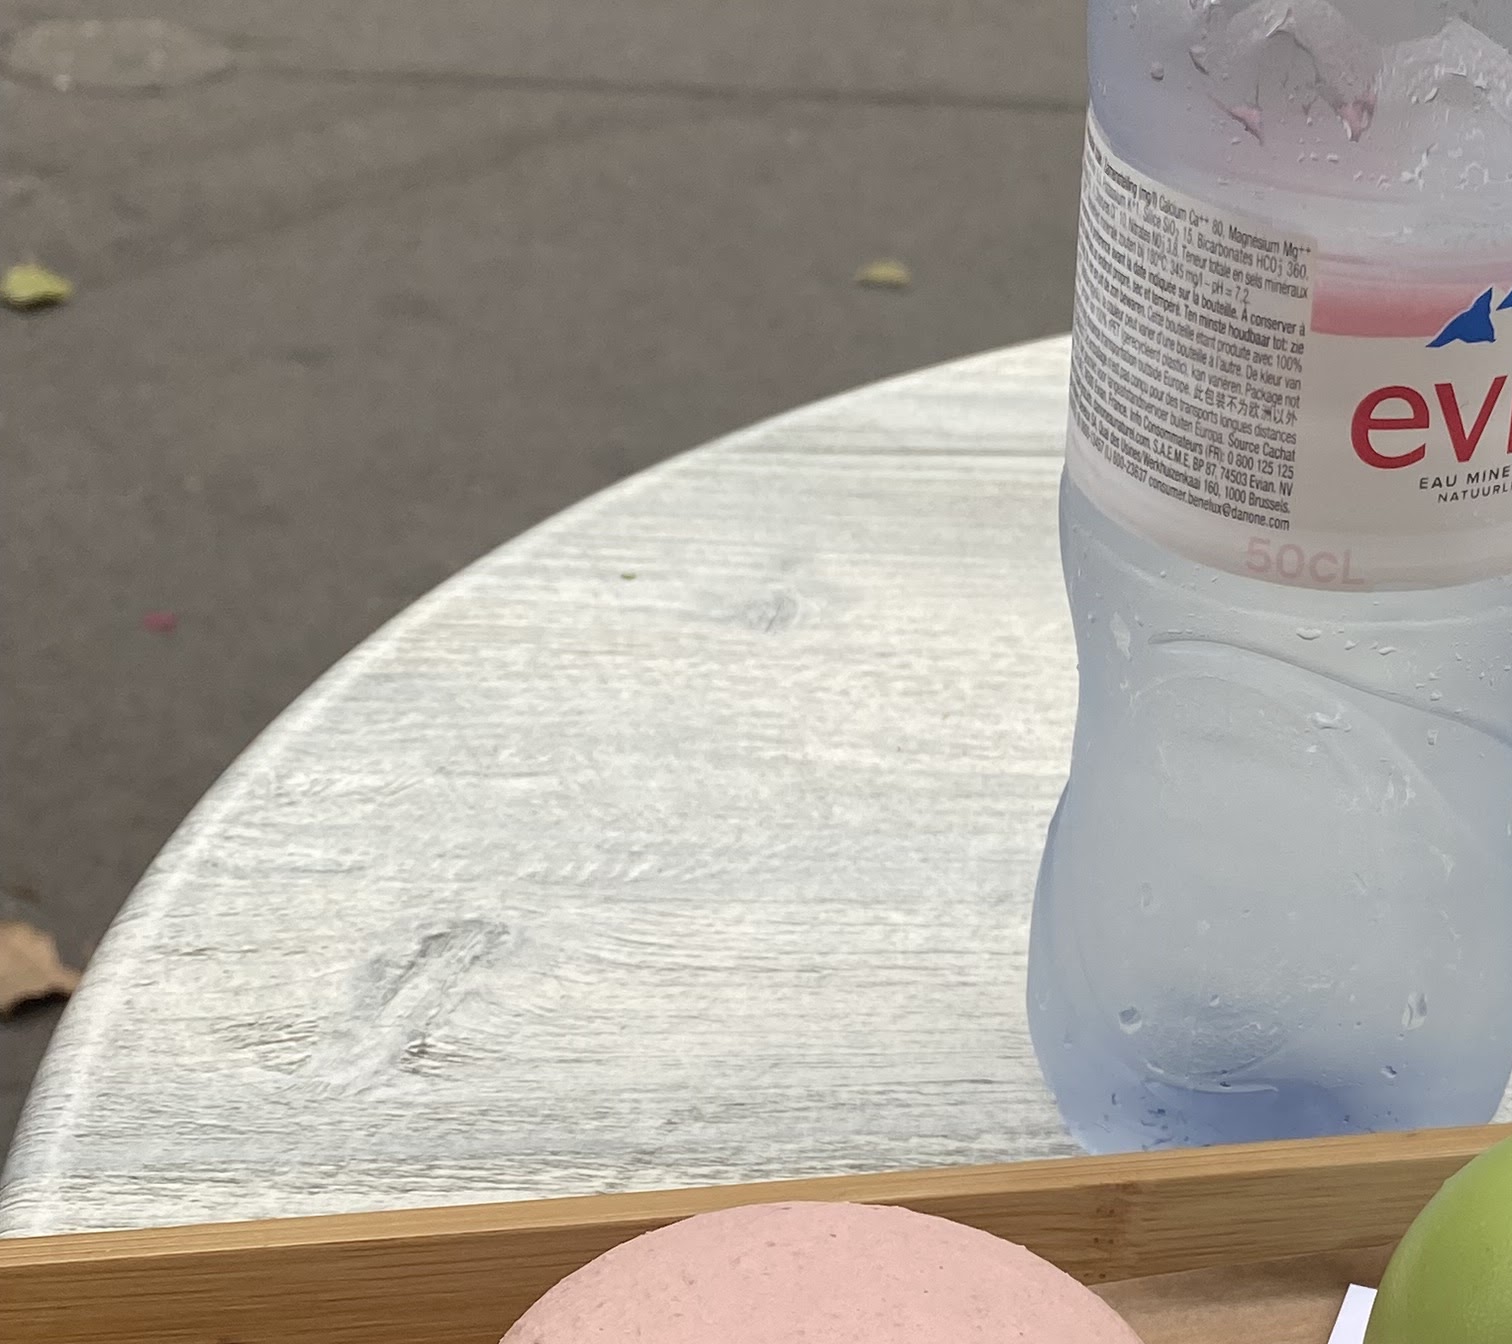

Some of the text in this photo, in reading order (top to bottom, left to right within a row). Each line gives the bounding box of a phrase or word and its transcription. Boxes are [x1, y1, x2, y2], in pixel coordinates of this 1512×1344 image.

[1232, 268, 1244, 283] en
[1250, 313, 1297, 335] conserver
[1246, 364, 1259, 382] De
[1260, 369, 1283, 387] kleur
[1284, 378, 1302, 391] van
[1276, 353, 1303, 374] 100%
[1245, 382, 1283, 408] Package
[1284, 394, 1300, 410] not
[1227, 431, 1260, 455] Source
[1262, 441, 1296, 463] Cachat
[1254, 422, 1298, 445] distances
[1192, 455, 1205, 472] BP
[1220, 465, 1248, 487] 74503
[1279, 480, 1294, 497] NV
[1227, 450, 1234, 466] 0
[1235, 453, 1254, 471] 800
[1257, 458, 1275, 476] 125
[1277, 463, 1295, 480] 125
[1419, 473, 1458, 490] EAU
[1148, 476, 1291, 532] consumer.benelux@danone.com
[1224, 485, 1247, 505] 1000
[1248, 491, 1291, 514] Brussels.
[1245, 536, 1366, 586] 50cL
